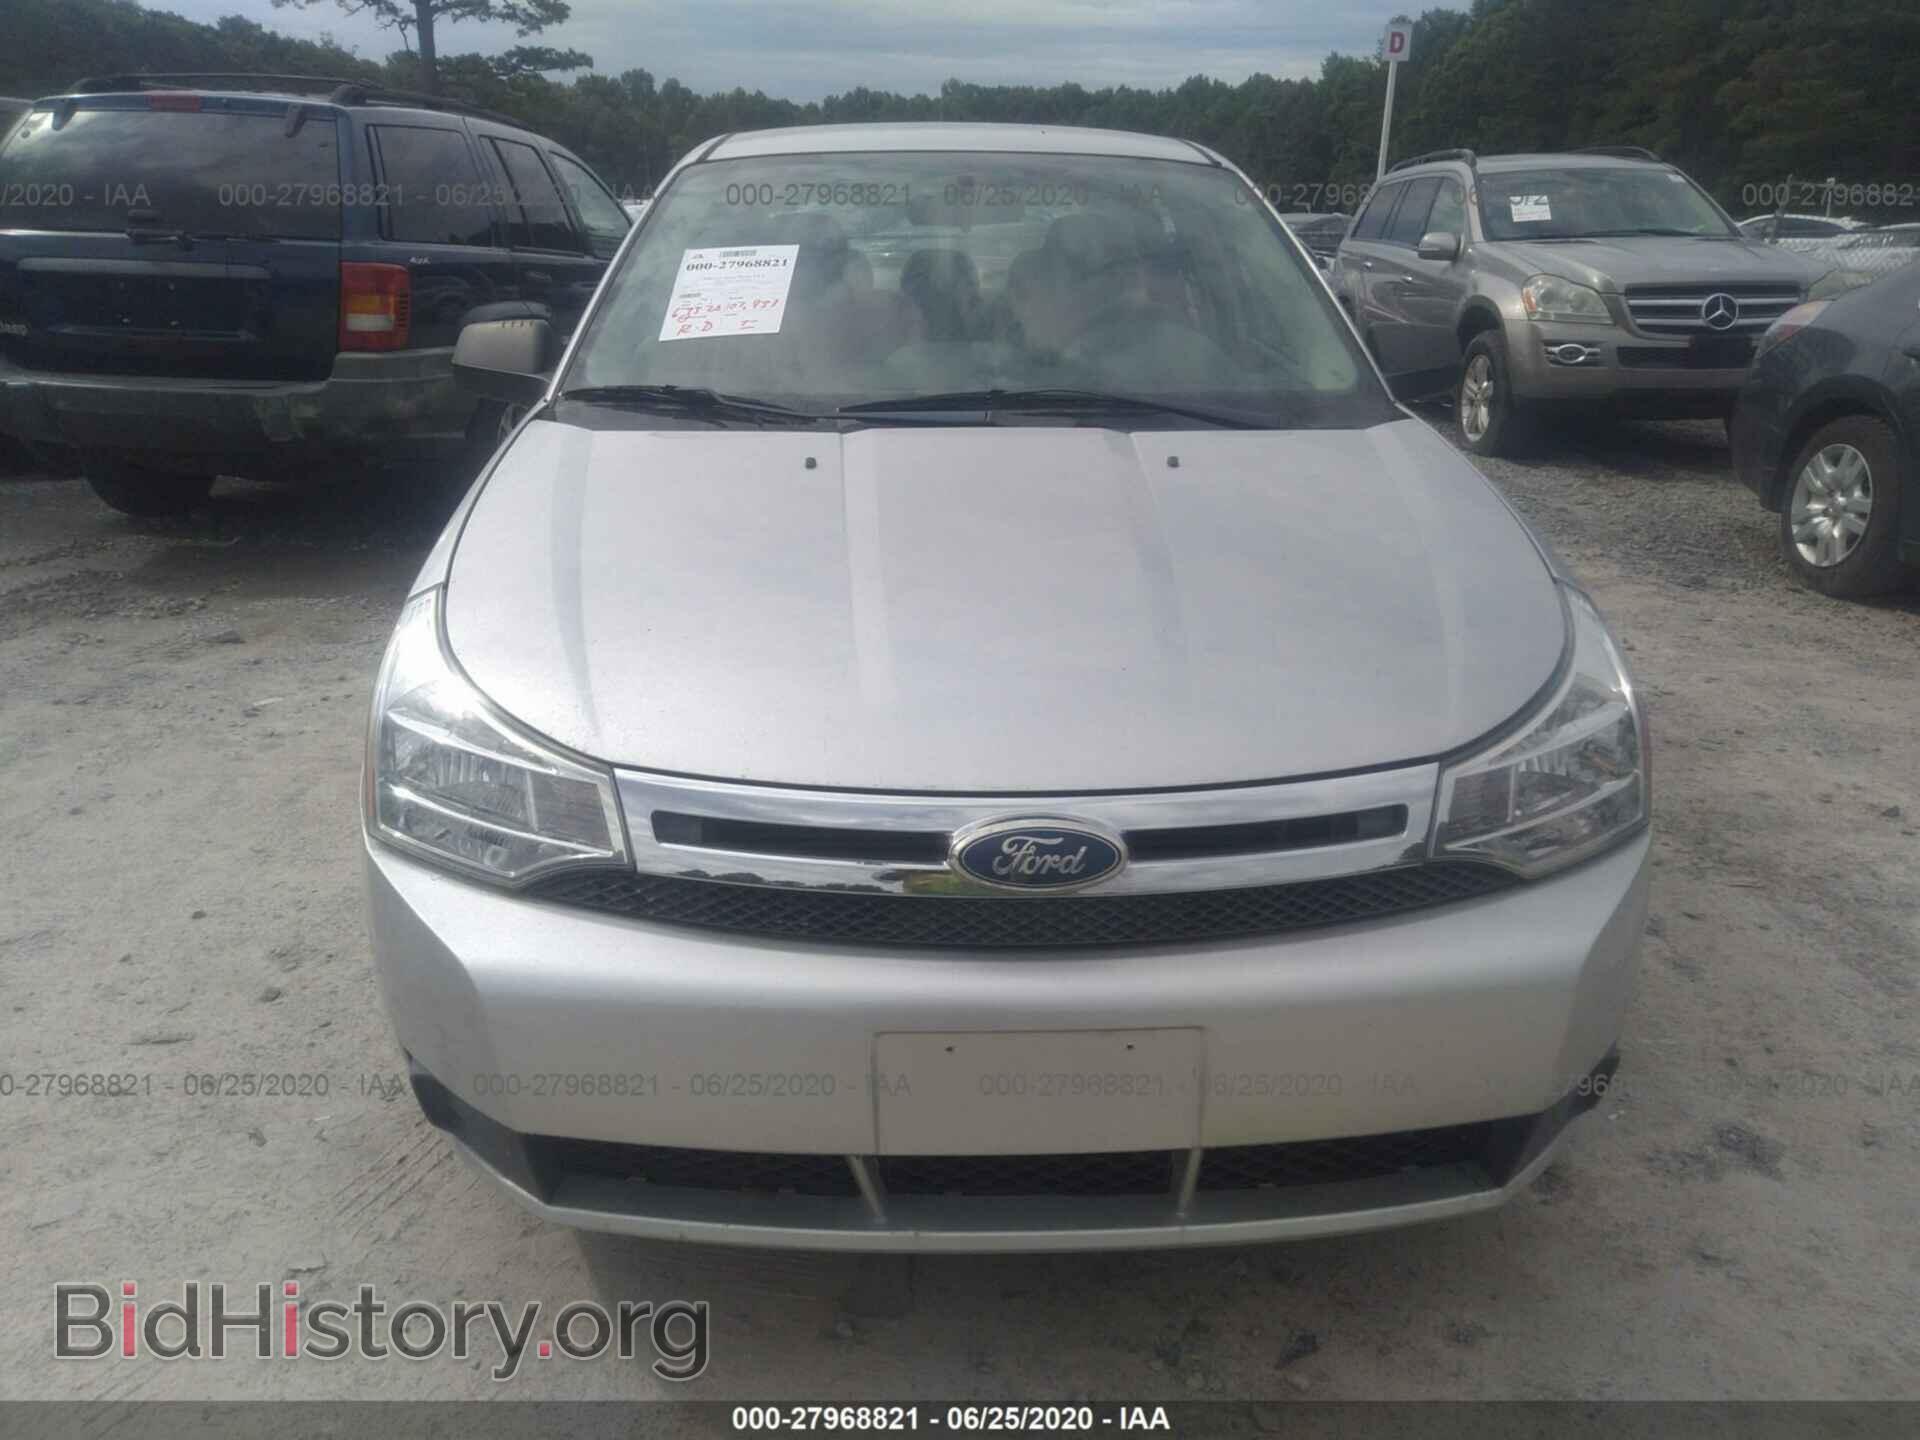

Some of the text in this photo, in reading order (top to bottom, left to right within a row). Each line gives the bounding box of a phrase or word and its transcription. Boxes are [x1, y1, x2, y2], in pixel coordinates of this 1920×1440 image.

[1389, 31, 1405, 54] D
[686, 257, 788, 272] 000-27968821
[991, 835, 1089, 876] Ford
